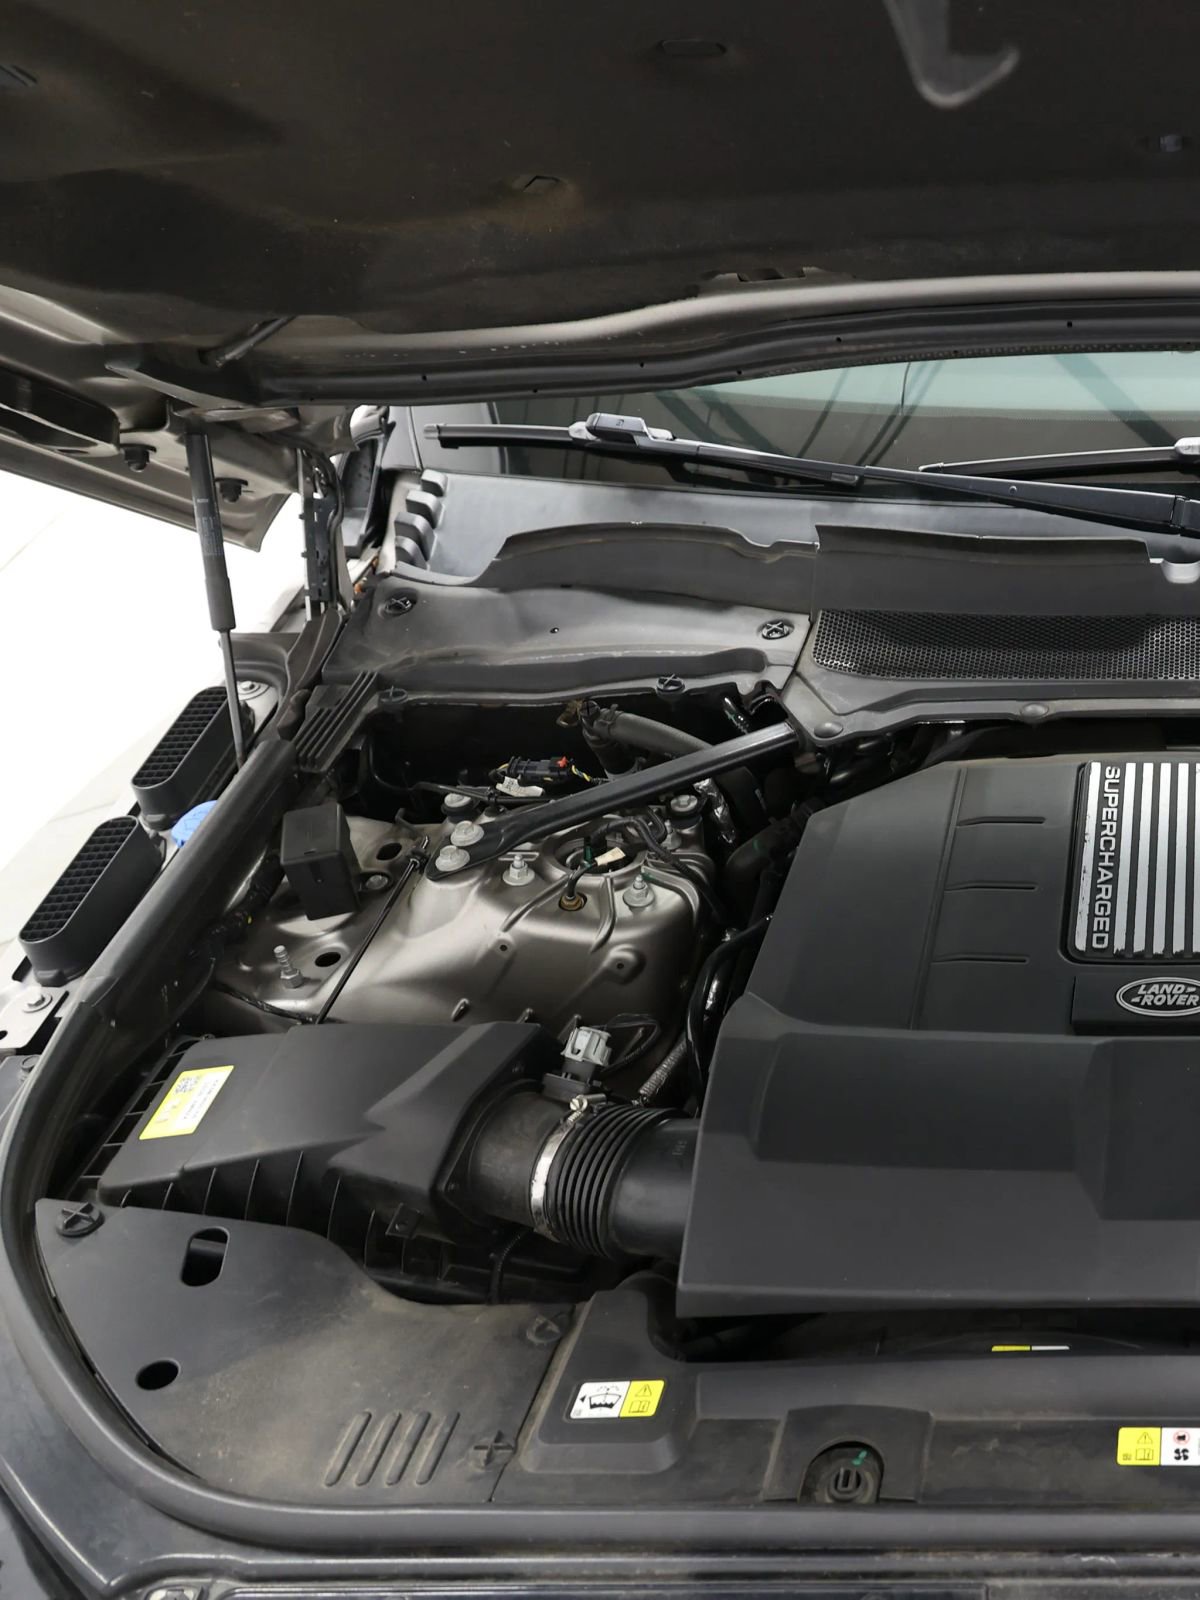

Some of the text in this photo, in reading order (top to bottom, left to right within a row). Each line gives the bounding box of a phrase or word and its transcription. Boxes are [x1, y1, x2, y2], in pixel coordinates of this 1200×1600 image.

[1092, 766, 1121, 949] SUPERCHARGED
[1137, 983, 1186, 995] LAND
[1140, 994, 1200, 1006] ROVER
